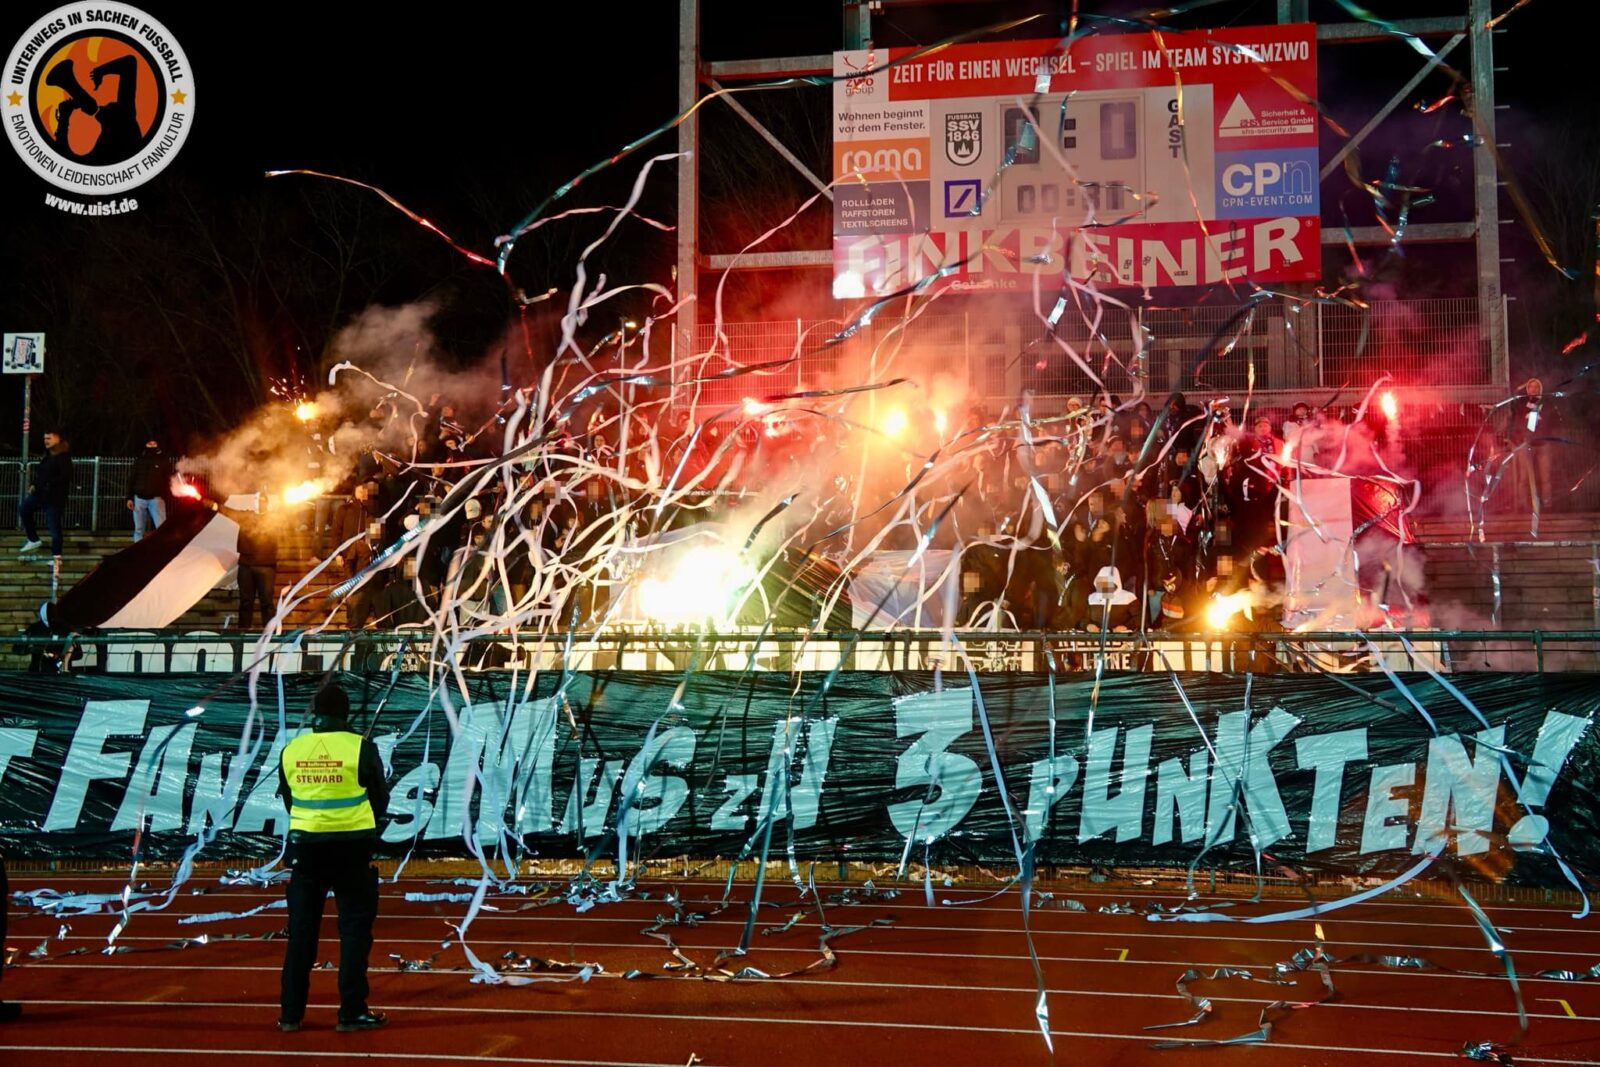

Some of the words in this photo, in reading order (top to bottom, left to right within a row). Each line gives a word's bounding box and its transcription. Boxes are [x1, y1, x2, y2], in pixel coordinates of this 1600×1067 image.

[893, 64, 924, 84] ZEIT
[927, 60, 954, 82] FÜR
[959, 59, 1001, 79] EINEN
[1005, 55, 1076, 78] WECHSEL
[1096, 52, 1137, 72] SPIEL
[1142, 50, 1161, 68] IM
[1166, 47, 1207, 67] TEAM
[838, 110, 881, 122] Wohnen
[884, 109, 924, 122] beginnt
[1261, 110, 1298, 118] Sicherheit
[838, 124, 858, 134] vor
[858, 122, 881, 133] dem
[884, 121, 926, 132] Fenster.
[947, 120, 980, 131] SSV
[1261, 118, 1289, 127] Service
[1290, 116, 1314, 125] GmbH
[947, 130, 980, 142] 1846
[841, 147, 922, 174] roma
[1222, 194, 1313, 208] CPN-EVENT.COM
[841, 208, 896, 218] RAFFSTOREN
[841, 218, 908, 229] TEXTILSCREENS
[848, 216, 1303, 298] FINKBEINER
[887, 686, 981, 842] 3
[1024, 706, 1592, 856] PUNKTEN!
[296, 774, 343, 784] STEWARD
